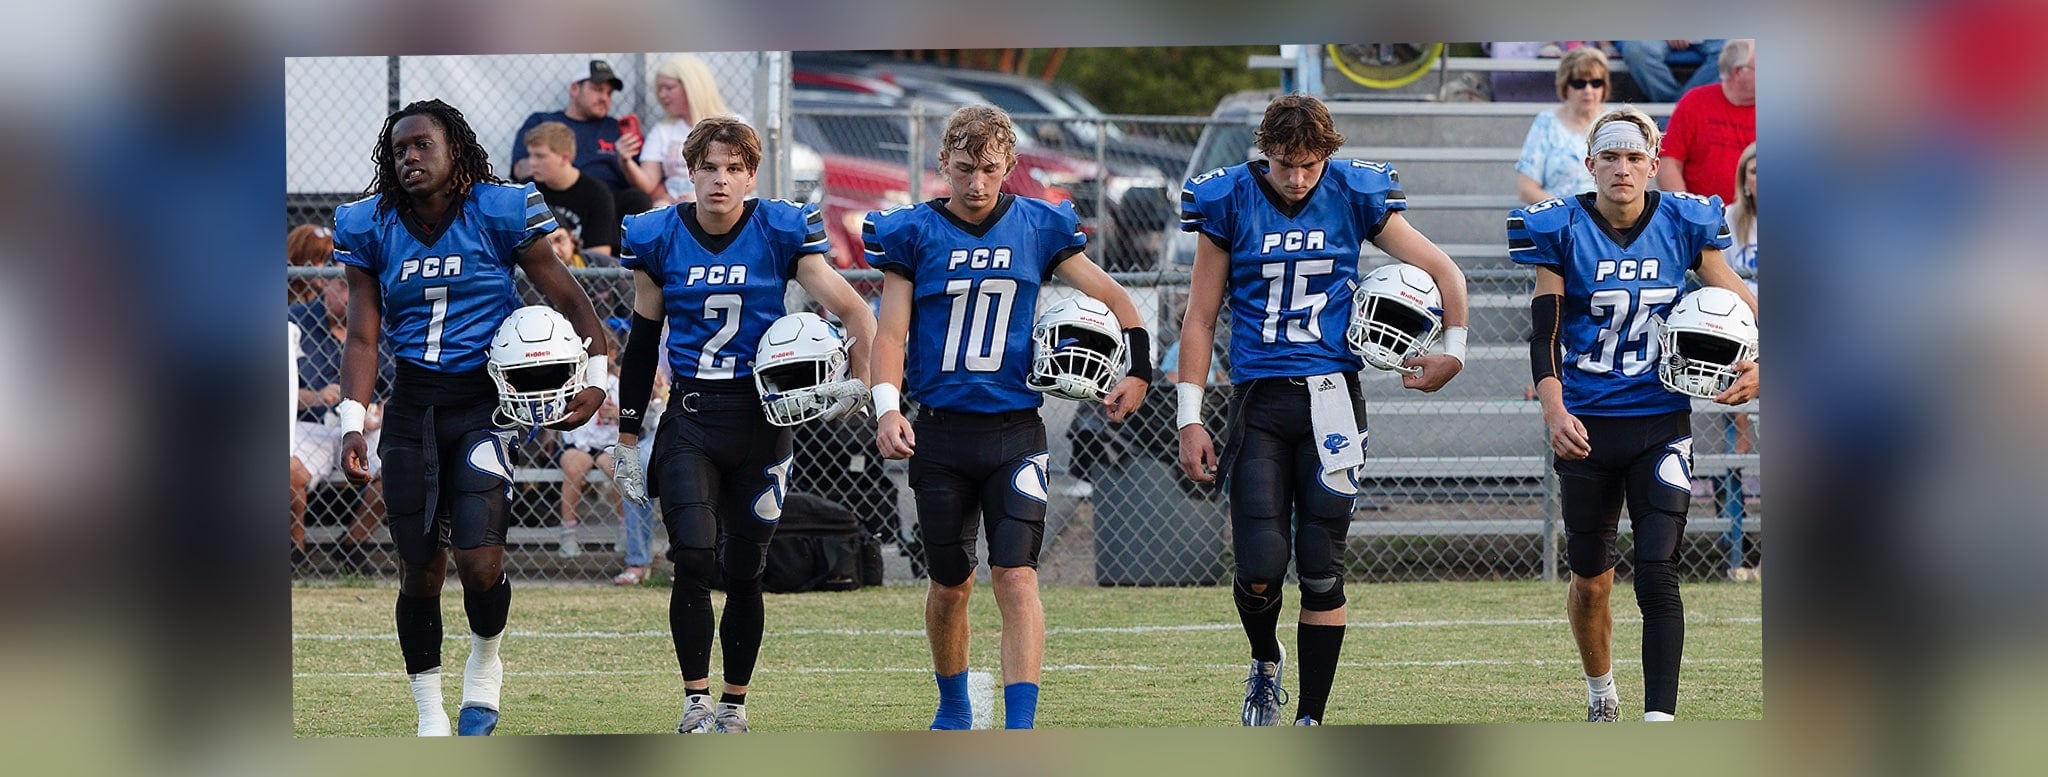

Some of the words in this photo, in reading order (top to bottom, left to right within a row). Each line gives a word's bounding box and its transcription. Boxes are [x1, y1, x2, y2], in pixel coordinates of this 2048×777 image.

[947, 247, 1012, 271] PCA
[1261, 230, 1325, 254] PCA
[400, 255, 463, 282] PCA
[685, 264, 748, 287] PCA
[1594, 259, 1660, 282] PCA
[422, 285, 449, 363] 1
[941, 278, 1018, 373] 10
[1261, 259, 1335, 344] 15
[694, 293, 743, 380] 2
[1576, 286, 1679, 377] 35
